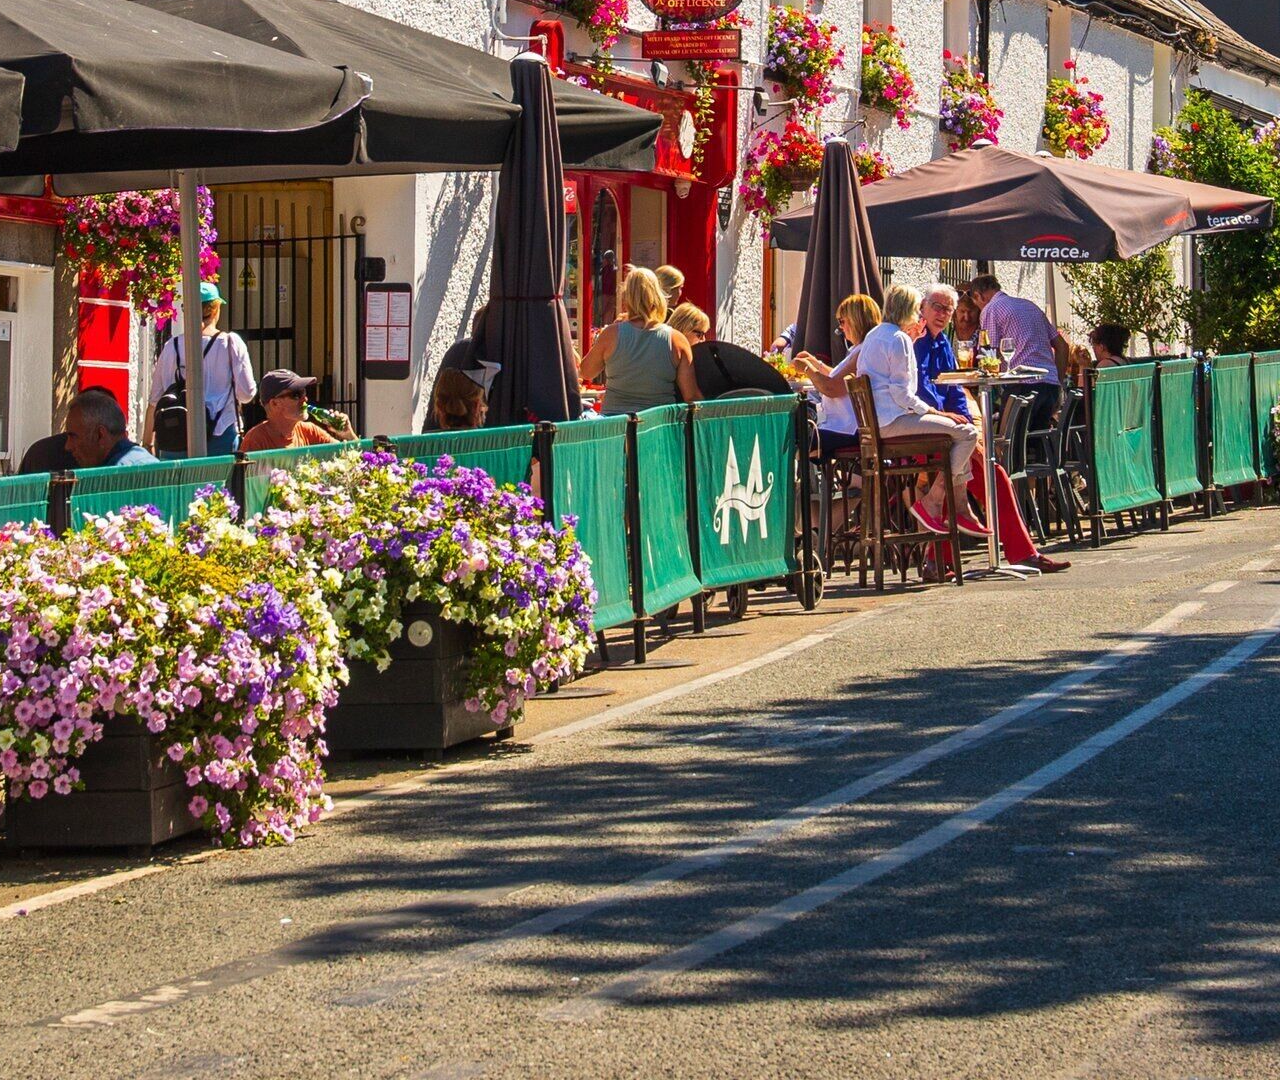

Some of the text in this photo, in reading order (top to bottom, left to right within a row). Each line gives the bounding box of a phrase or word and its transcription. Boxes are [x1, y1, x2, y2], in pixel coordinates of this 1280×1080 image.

[667, 0, 685, 8] OFF
[1207, 213, 1260, 227] terrace.ie
[1020, 245, 1090, 259] terrace.ie
